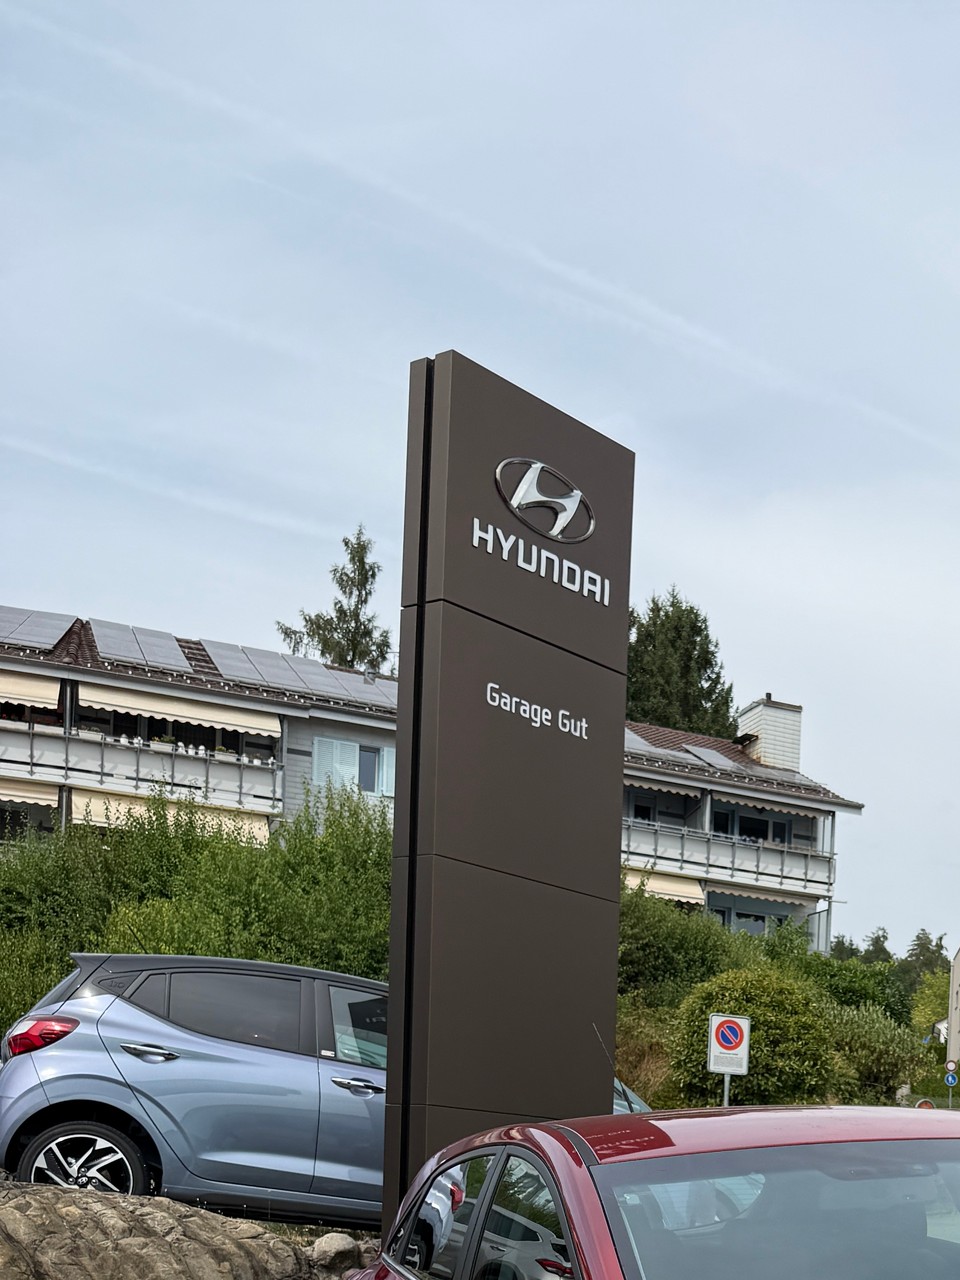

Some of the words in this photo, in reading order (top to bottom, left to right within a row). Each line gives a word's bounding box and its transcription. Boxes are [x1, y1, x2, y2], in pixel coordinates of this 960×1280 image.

[472, 517, 610, 607] HYUNDAI
[486, 682, 551, 728] Garage
[558, 709, 589, 740] Gut
